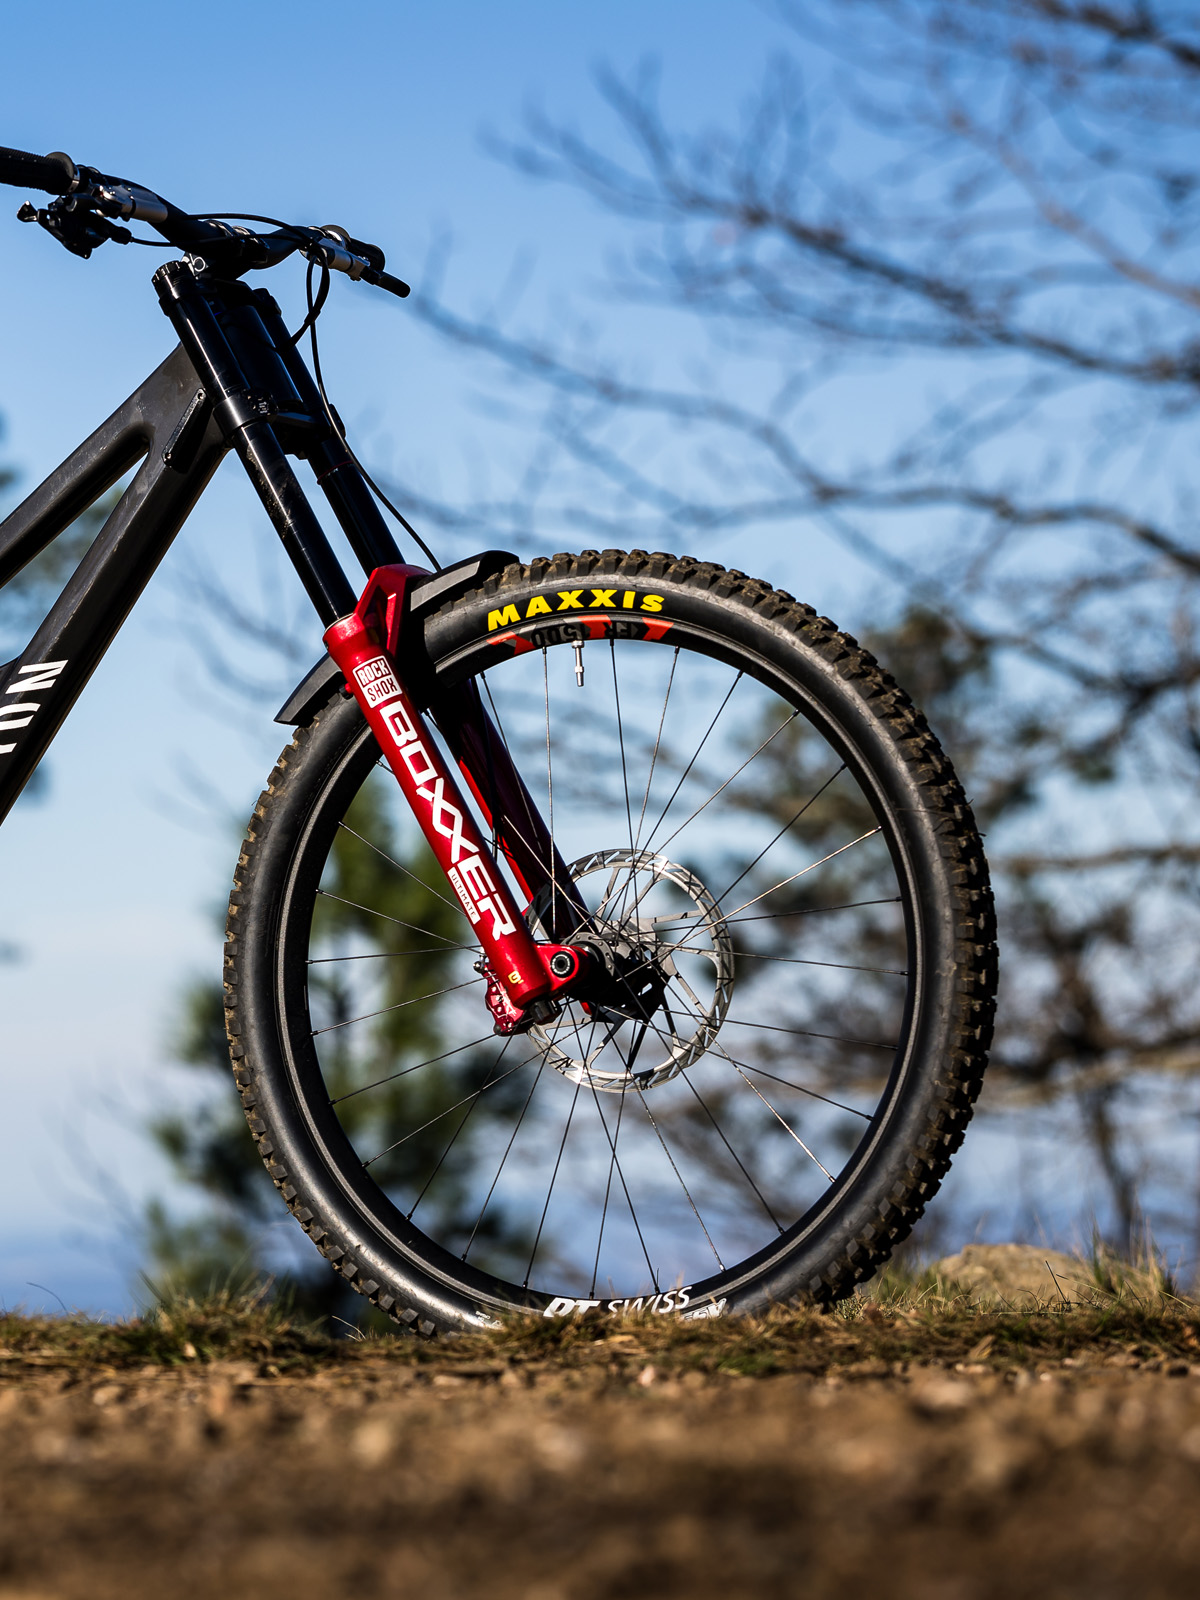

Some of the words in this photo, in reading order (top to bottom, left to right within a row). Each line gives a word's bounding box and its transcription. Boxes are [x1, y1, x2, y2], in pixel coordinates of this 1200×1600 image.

[487, 589, 665, 632] MAXXIS
[357, 658, 389, 686] ROCK
[366, 673, 400, 702] SHOX
[380, 700, 517, 941] BOXXER
[451, 875, 477, 918] ULTIMATE
[543, 1297, 600, 1317] DT
[607, 1286, 692, 1318] SWISS
